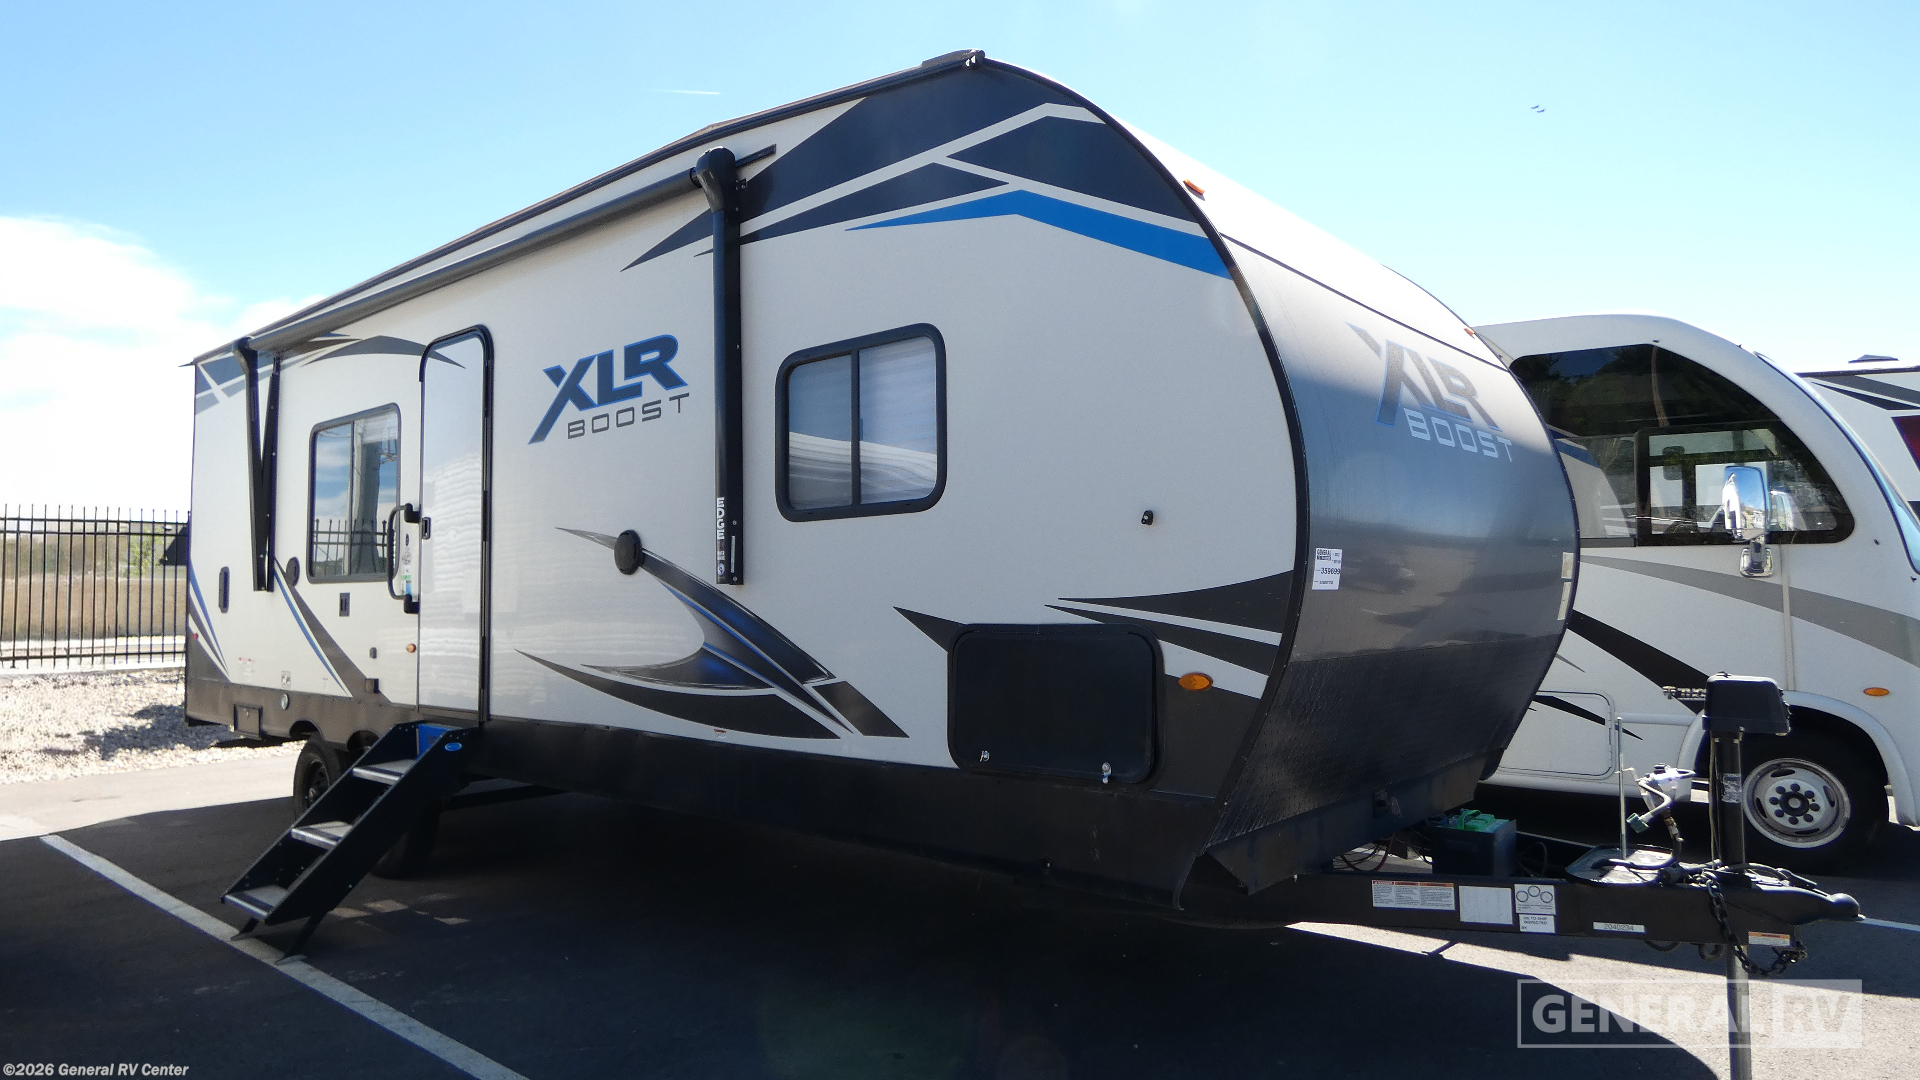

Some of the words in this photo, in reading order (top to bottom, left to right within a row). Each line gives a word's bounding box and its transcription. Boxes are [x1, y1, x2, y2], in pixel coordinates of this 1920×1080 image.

[528, 334, 688, 445] XLR
[1346, 322, 1503, 432] XLR
[567, 392, 690, 439] BOOST
[1404, 407, 1513, 462] BOOST
[716, 497, 725, 540] EDGE
